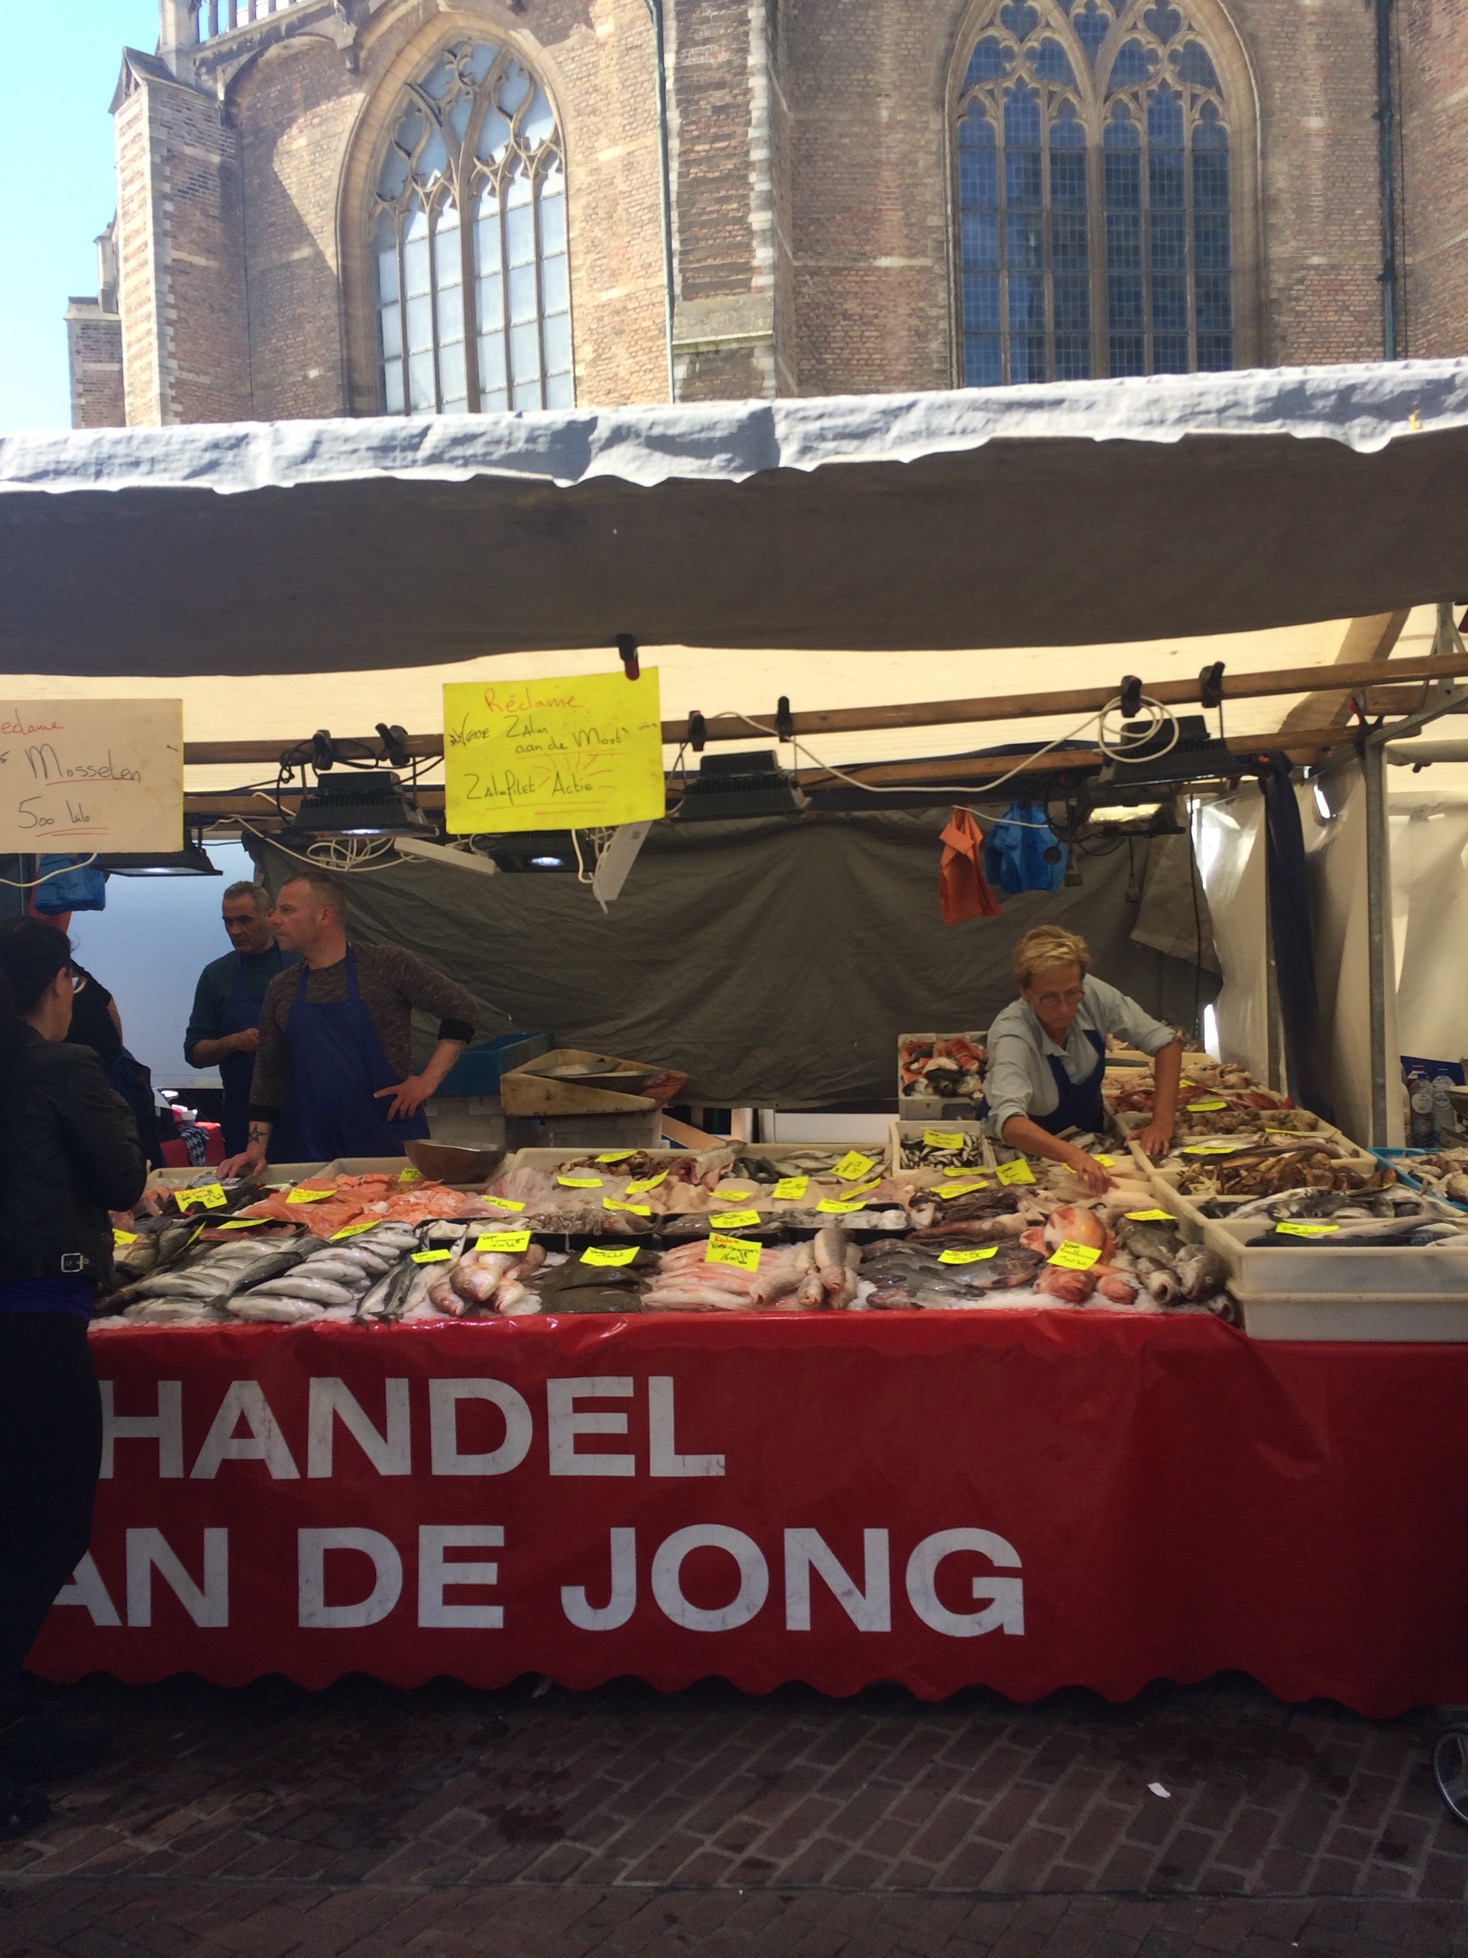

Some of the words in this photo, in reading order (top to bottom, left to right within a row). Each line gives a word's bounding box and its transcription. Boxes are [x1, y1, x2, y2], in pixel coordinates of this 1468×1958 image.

[98, 1376, 726, 1480] HANDEL
[297, 1524, 505, 1629] DE
[560, 1523, 1025, 1638] JONG
